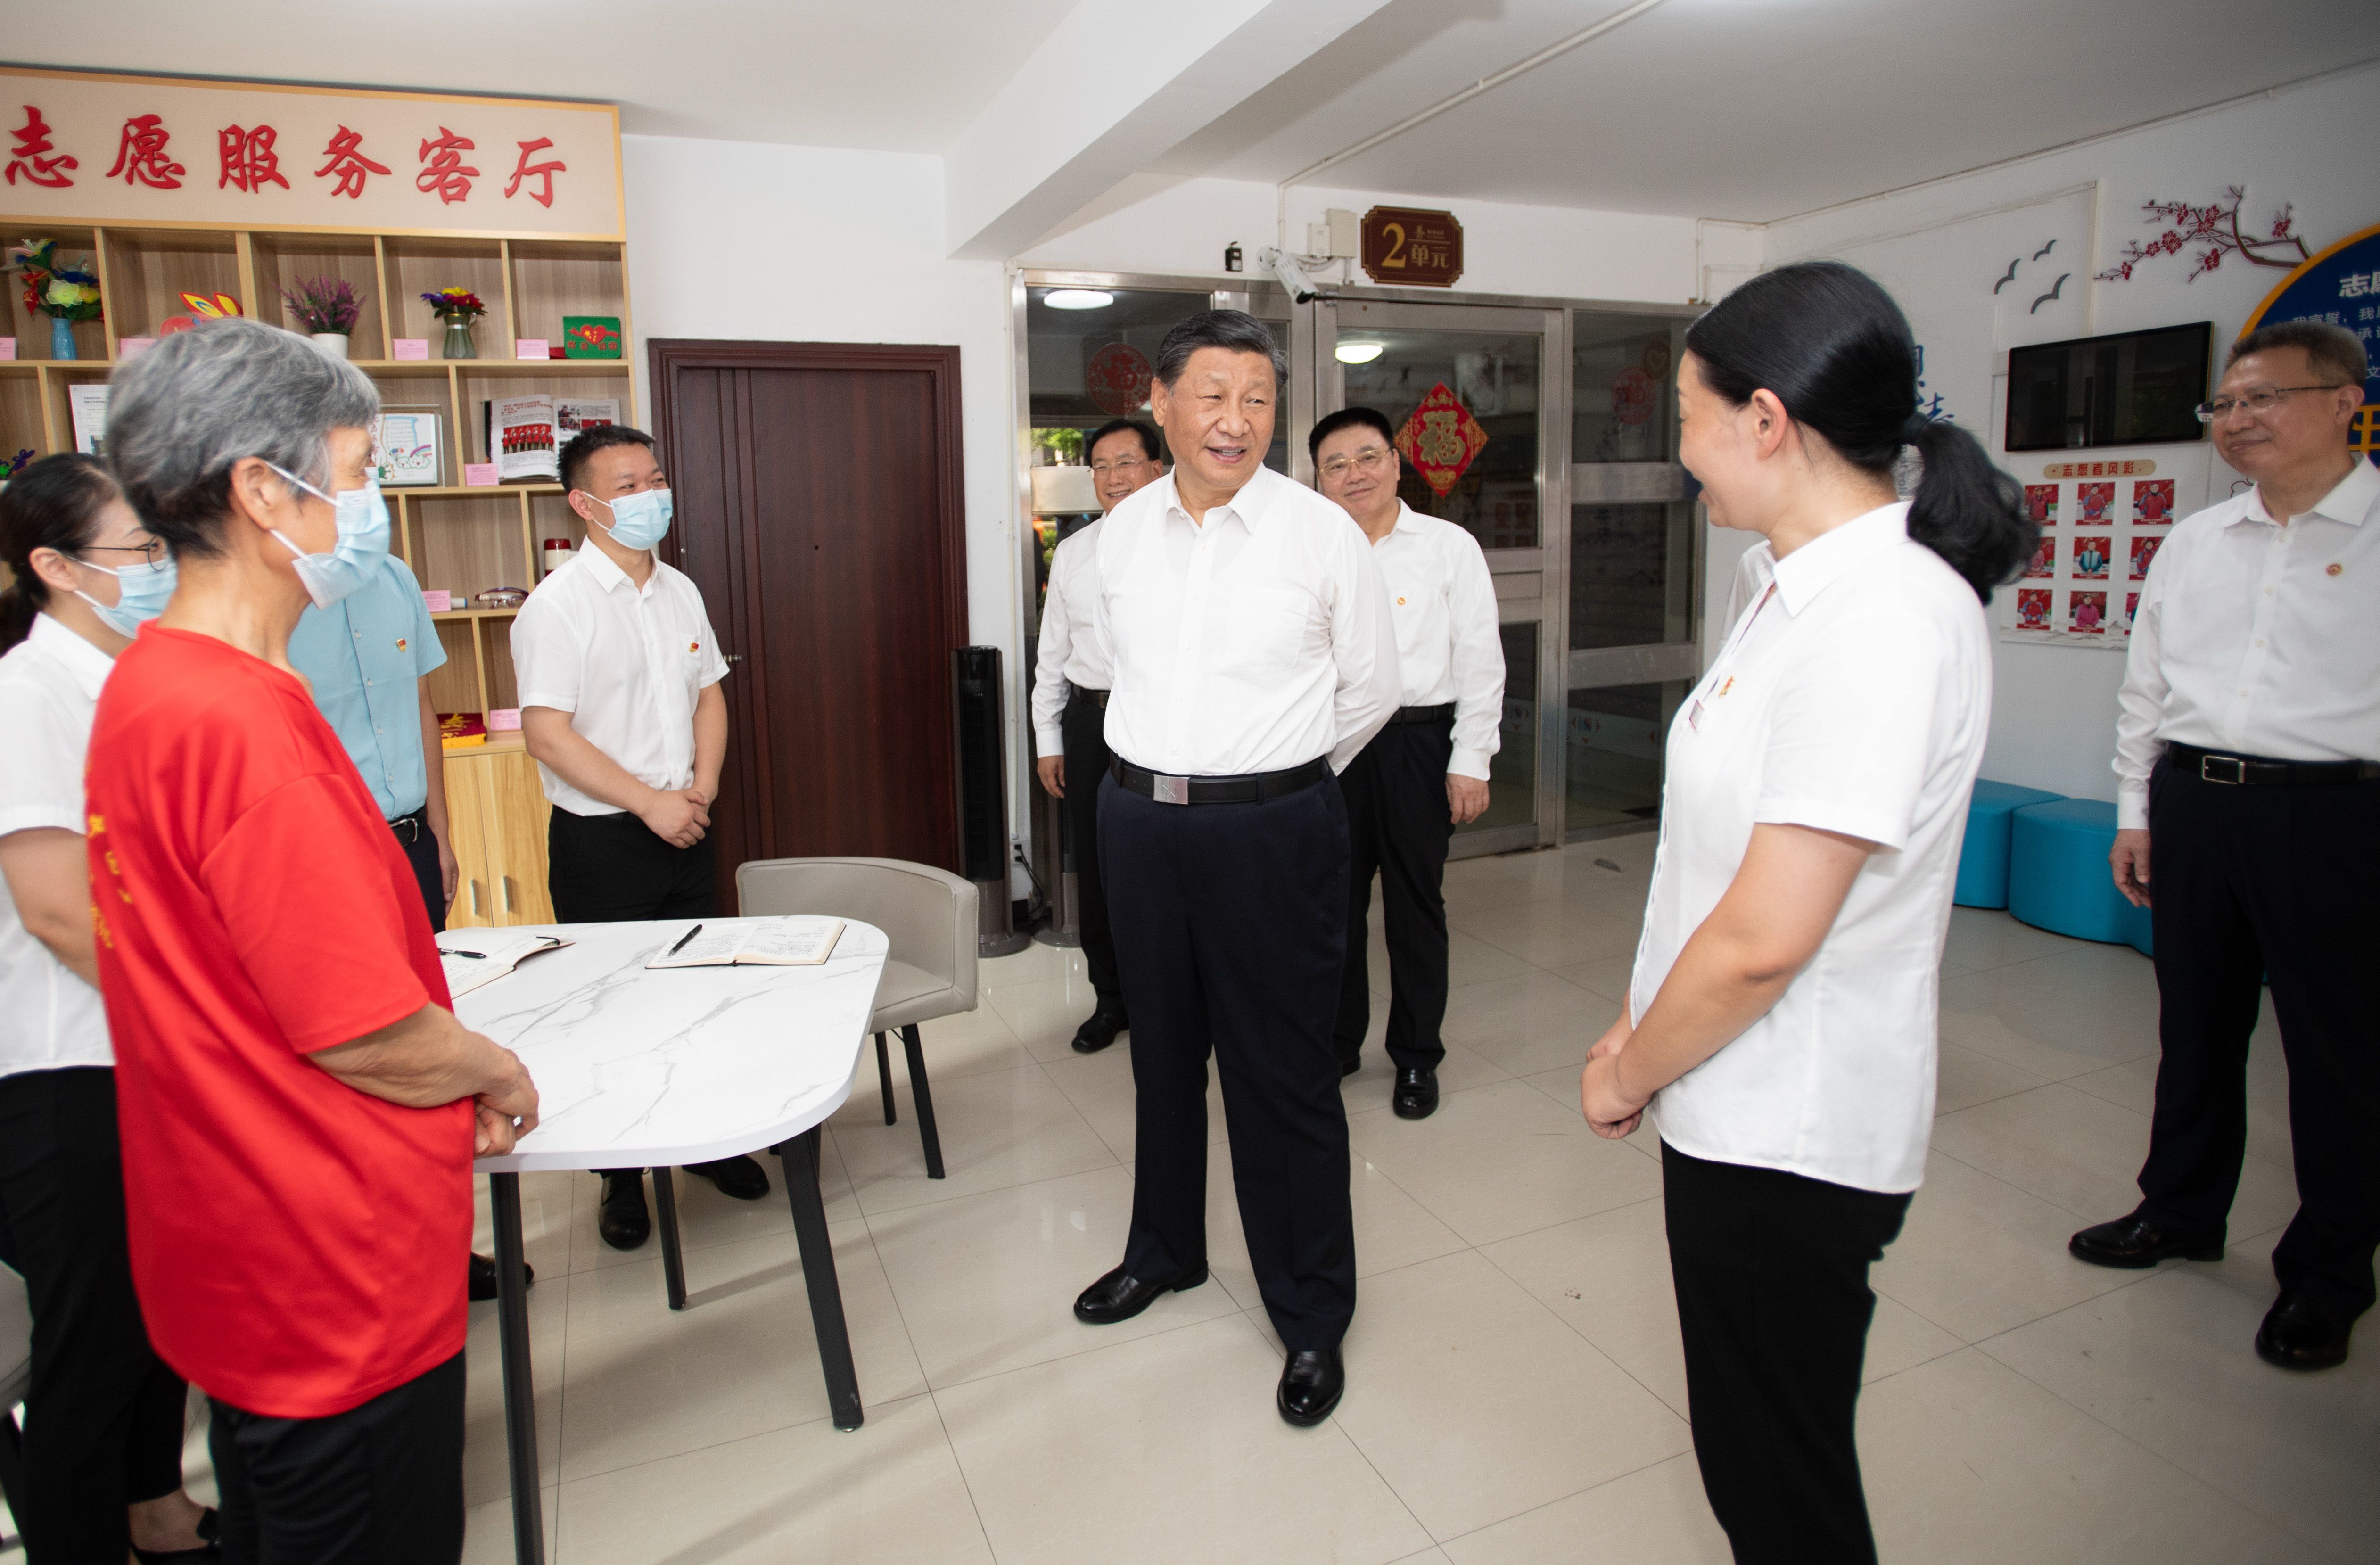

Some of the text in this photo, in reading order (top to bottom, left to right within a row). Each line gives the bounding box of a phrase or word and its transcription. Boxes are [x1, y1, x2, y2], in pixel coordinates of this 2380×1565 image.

[4, 105, 566, 208] 志愿服务客厅
[1381, 222, 1450, 269] 2 单元
[1417, 410, 1466, 467] 福
[2063, 461, 2134, 477] 志愿者风彩
